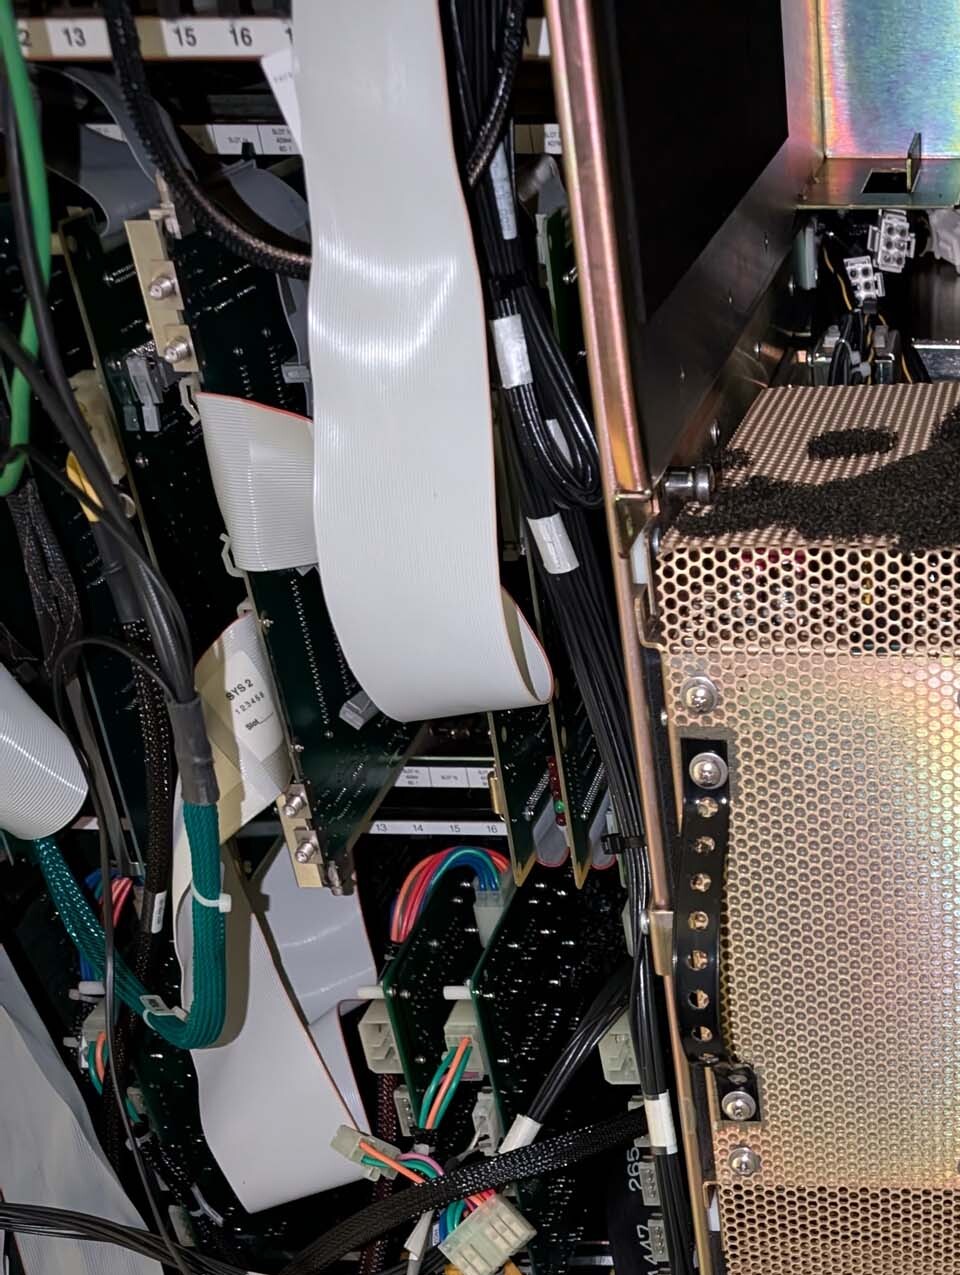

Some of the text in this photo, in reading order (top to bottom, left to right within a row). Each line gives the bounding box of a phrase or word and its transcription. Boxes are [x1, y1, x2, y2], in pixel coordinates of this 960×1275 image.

[62, 27, 87, 47] 13
[173, 26, 198, 47] 15
[229, 26, 253, 47] 16
[225, 679, 254, 701] SYS 2
[375, 823, 498, 833] 13 14 15 16
